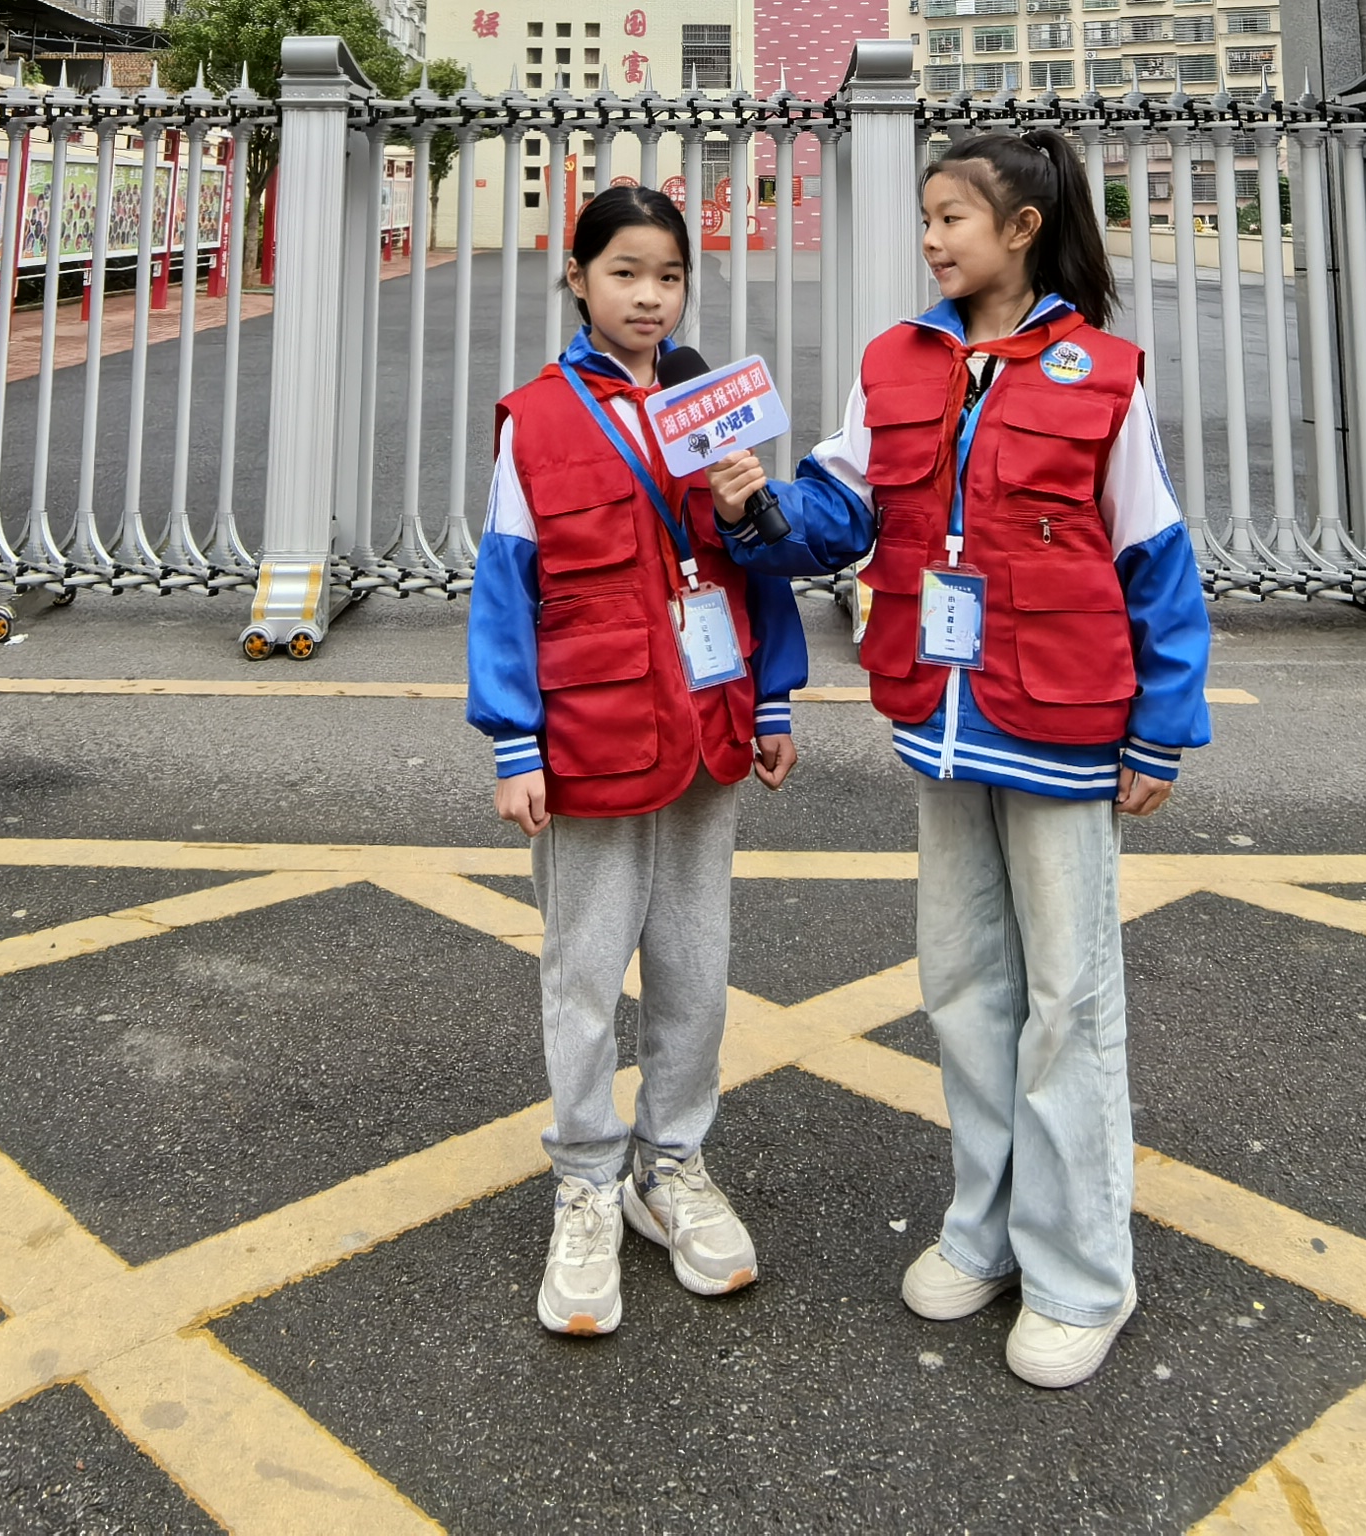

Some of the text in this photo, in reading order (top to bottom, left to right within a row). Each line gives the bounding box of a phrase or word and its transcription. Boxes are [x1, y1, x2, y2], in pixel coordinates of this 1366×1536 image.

[661, 366, 767, 438] 湖南教育报刊集团
[714, 404, 756, 439] 小记者
